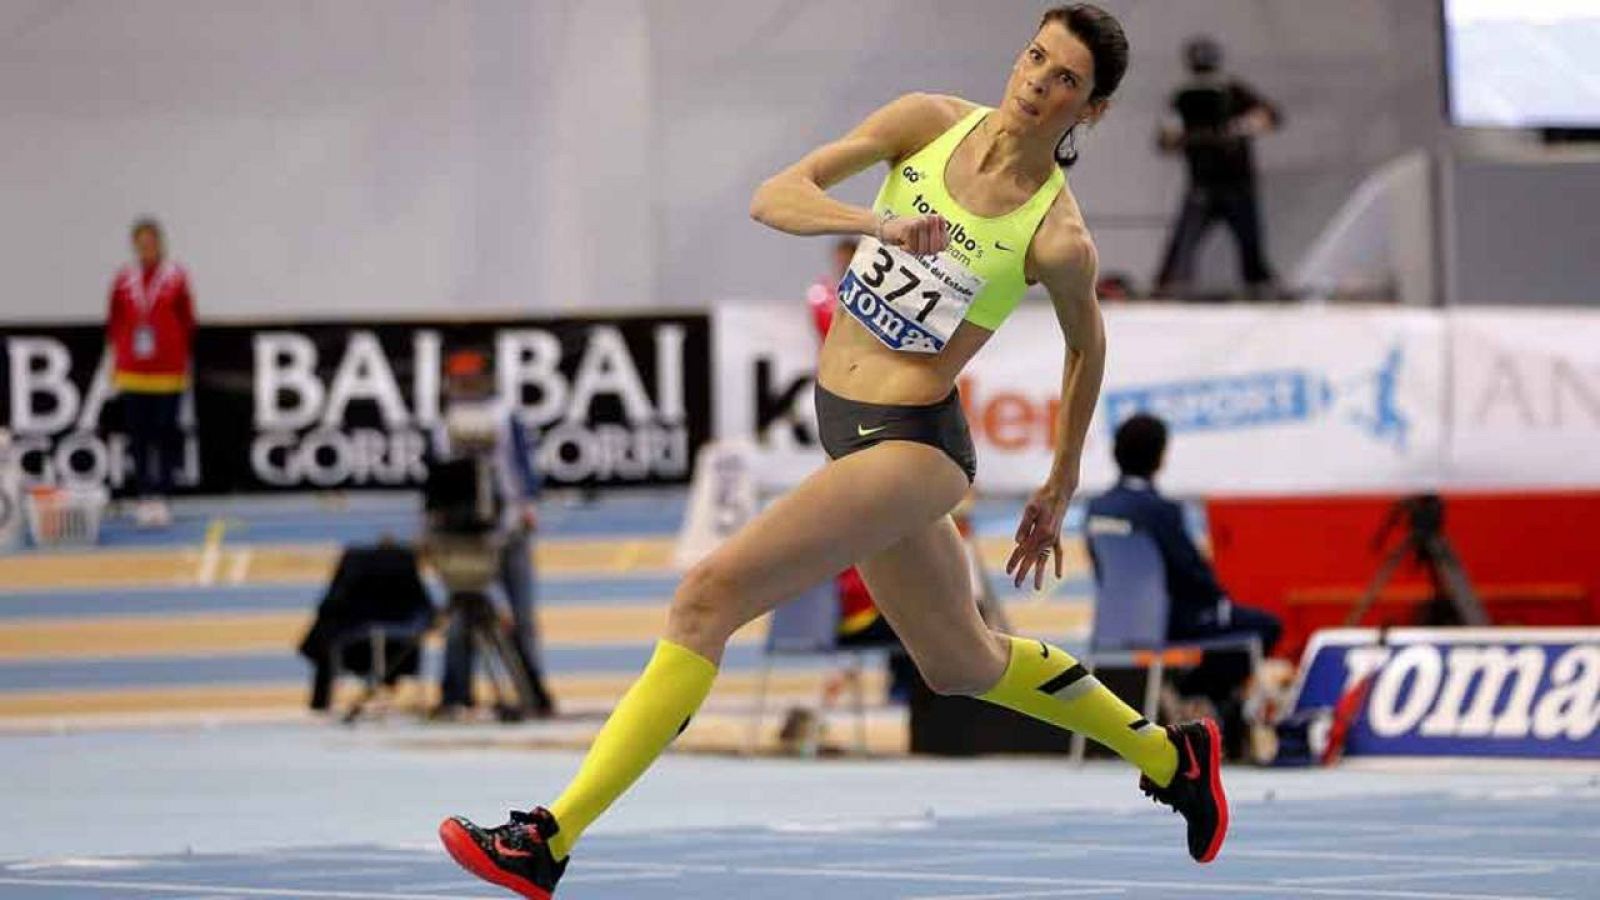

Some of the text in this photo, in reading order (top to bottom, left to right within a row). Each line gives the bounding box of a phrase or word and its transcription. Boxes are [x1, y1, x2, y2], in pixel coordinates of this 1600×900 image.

[862, 247, 942, 324] 371
[254, 329, 441, 430] BAI
[496, 325, 685, 428] BAI
